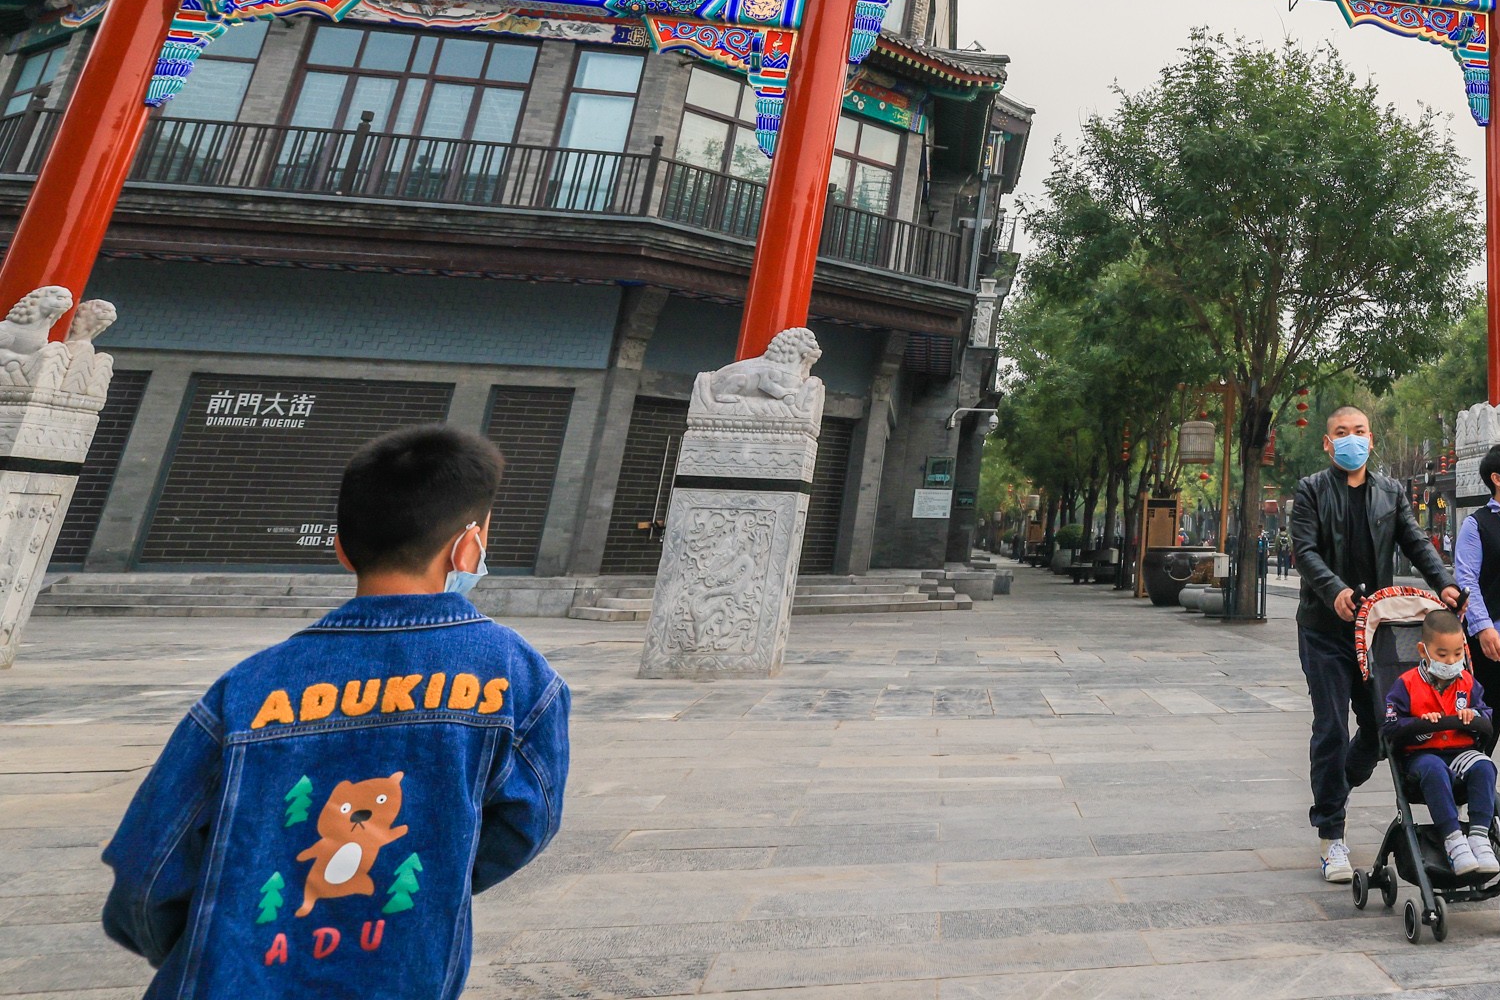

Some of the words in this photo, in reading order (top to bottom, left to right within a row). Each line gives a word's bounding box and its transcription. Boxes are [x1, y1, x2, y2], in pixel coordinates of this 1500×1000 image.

[206, 390, 316, 417] 前門大街
[206, 416, 257, 427] QIANMEN
[261, 418, 305, 428] AVENUE
[251, 672, 509, 729] ADUKIDS
[264, 919, 385, 966] ADU
